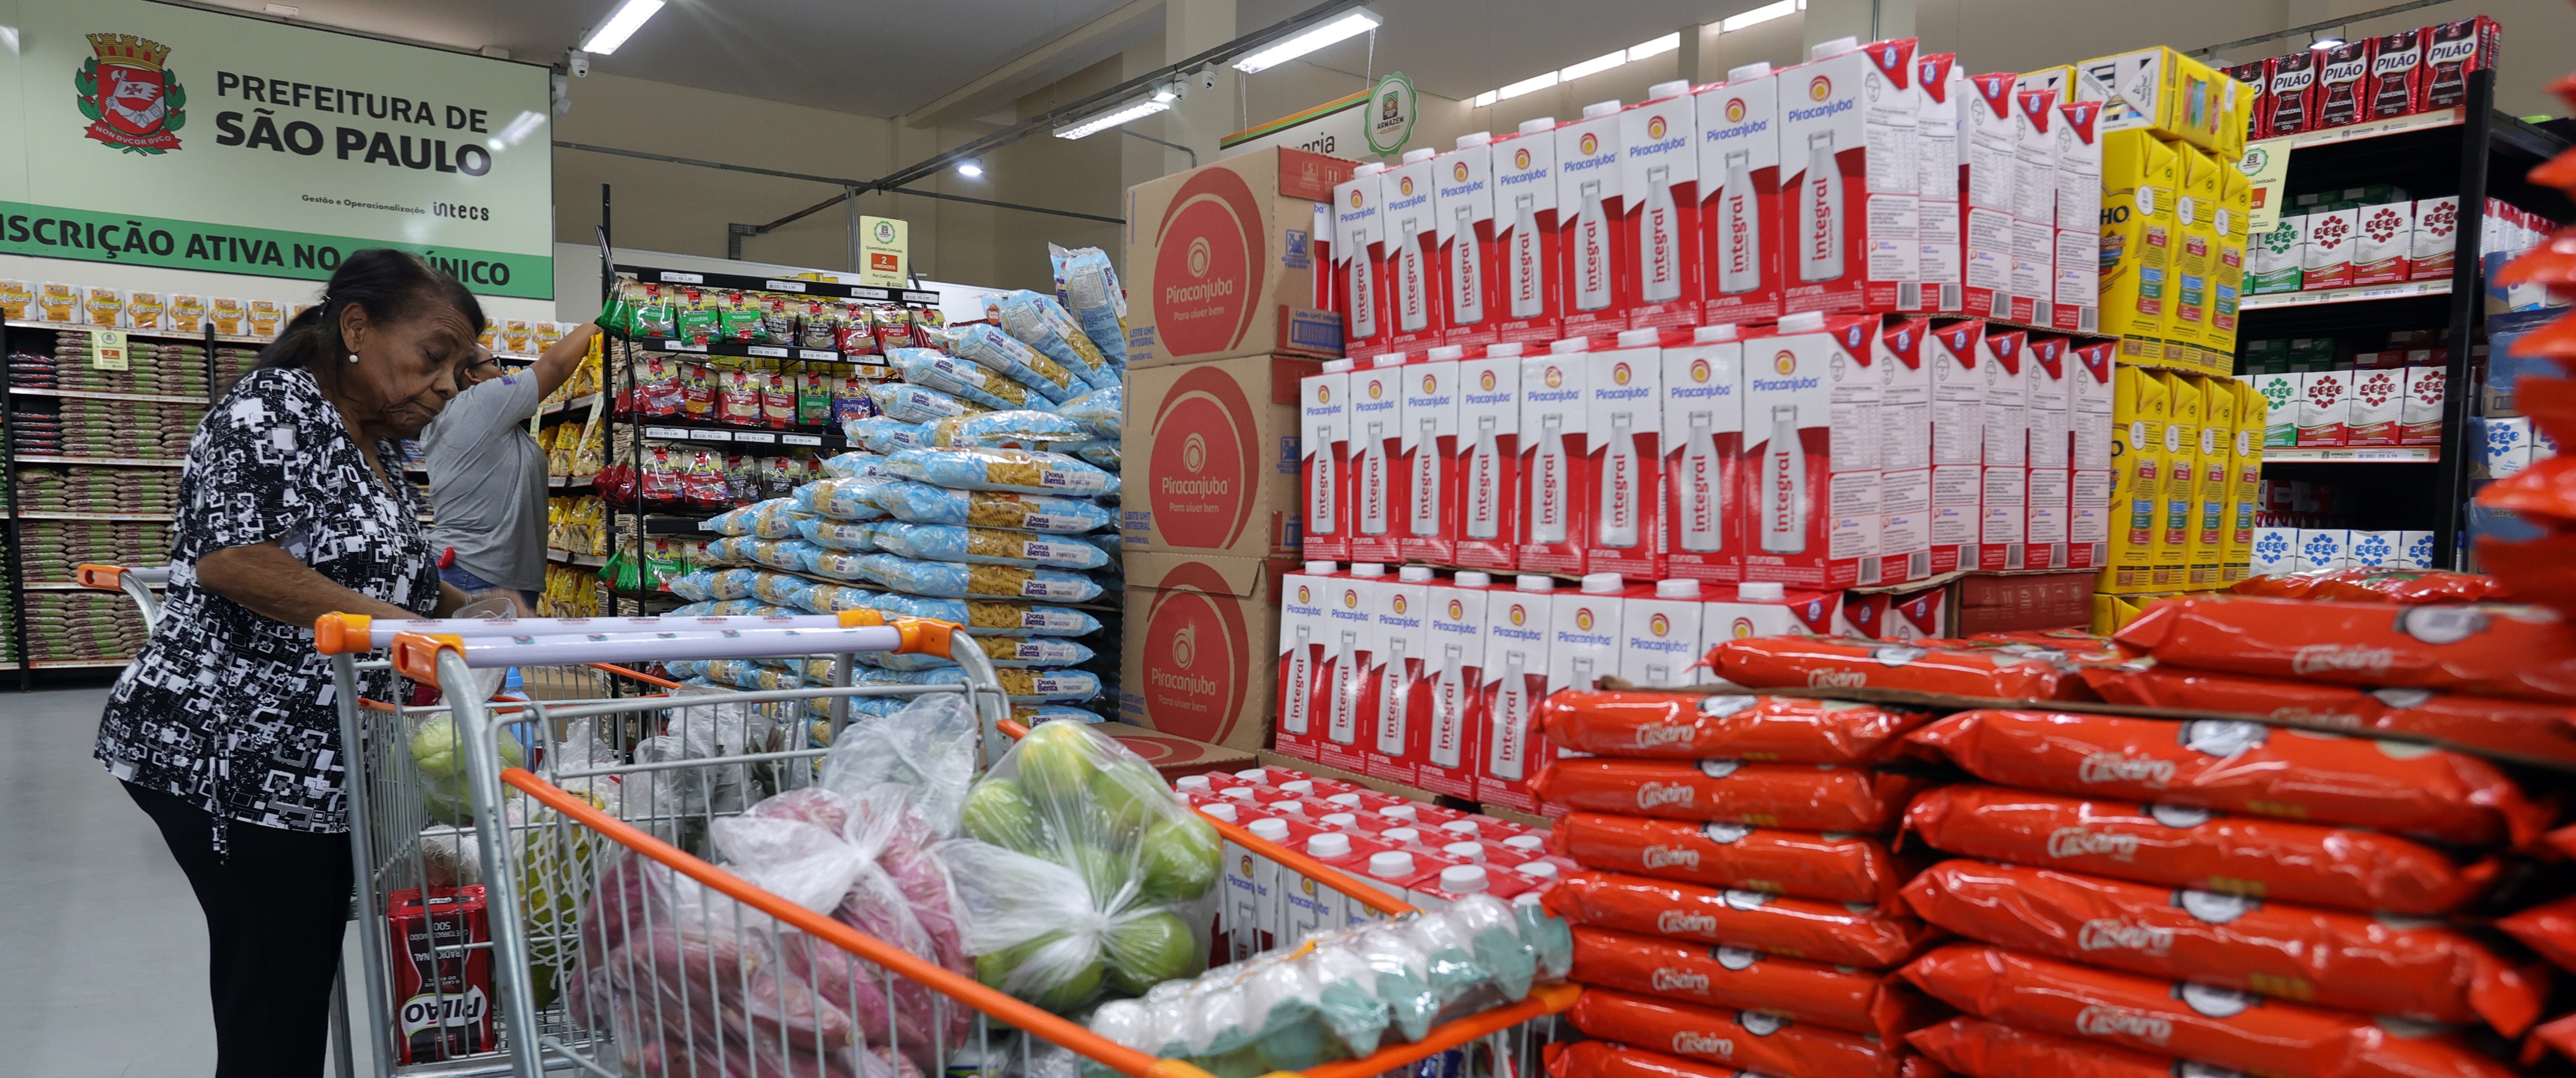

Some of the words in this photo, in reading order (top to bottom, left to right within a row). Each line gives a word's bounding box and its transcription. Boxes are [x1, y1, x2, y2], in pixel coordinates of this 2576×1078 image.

[2430, 42, 2473, 61] PILÃO
[2323, 63, 2362, 81] PILÃO
[2376, 53, 2417, 71] PILÃO
[2274, 73, 2311, 90] PILÃO
[217, 70, 436, 126] PREFEITURA
[446, 105, 487, 134] DE
[1789, 99, 1853, 122] Piracanjuba
[95, 126, 115, 138] NON
[1377, 115, 1404, 131] ARMAZÉM
[1707, 121, 1767, 142] Piracanjuba
[216, 107, 323, 156] SÃO
[336, 127, 491, 177] PAULO
[1630, 137, 1685, 157] Piracanjuba
[1564, 155, 1616, 173] Piracanjuba
[1501, 169, 1547, 186] Piracanjuba
[1441, 181, 1483, 198] Piracanjuba
[302, 195, 334, 204] Gestão
[344, 200, 425, 215] Operacionalização
[433, 202, 489, 221] intecs
[1389, 195, 1426, 211] Piracanjuba
[1340, 206, 1376, 223] Piracanjuba
[1811, 177, 1830, 262] integral
[2365, 217, 2402, 232] gege
[0, 214, 174, 259] SCRIÇÃO
[185, 233, 284, 267] ATIVA
[294, 244, 340, 271] NO
[1730, 195, 1746, 274] integral
[2265, 230, 2298, 245] gege
[2314, 225, 2349, 240] gege
[1585, 220, 1599, 292] integral
[1652, 208, 1667, 284] integral
[1461, 242, 1472, 308] integral
[1519, 232, 1533, 300] integral
[1166, 277, 1232, 304] Piracanjuba
[1356, 262, 1367, 323] integral
[1406, 252, 1418, 316] integral
[1174, 312, 1189, 321] Para
[1190, 309, 1207, 318] viver
[1209, 306, 1224, 315] bem
[1596, 386, 1648, 400] Piracanjuba
[1671, 384, 1730, 399] Piracanjuba
[1753, 377, 1818, 392] Piracanjuba
[2261, 386, 2294, 399] gege
[2308, 385, 2343, 399] gege
[2360, 383, 2396, 396] gege
[1356, 401, 1394, 412] Piracanjuba
[1409, 396, 1450, 408] Piracanjuba
[1466, 392, 1510, 405] Piracanjuba
[1529, 390, 1578, 403] Piracanjuba
[1307, 405, 1341, 416] Piracanjuba
[1162, 476, 1227, 499] Piracanjuba
[1317, 459, 1329, 519] integral
[1368, 457, 1380, 519] integral
[1418, 455, 1432, 519] integral
[1475, 454, 1490, 521] integral
[1540, 454, 1555, 525] integral
[1613, 454, 1628, 527] integral
[1692, 455, 1708, 533] integral
[1773, 451, 1793, 533] integral
[1170, 503, 1184, 512] Para
[2256, 541, 2289, 553] gege
[2304, 543, 2339, 555] gege
[2355, 544, 2392, 557] gege
[1287, 604, 1321, 617] Piracanjuba
[1332, 609, 1369, 622] Piracanjuba
[1379, 614, 1420, 629] Piracanjuba
[1434, 620, 1477, 634] Piracanjuba
[1493, 626, 1541, 641] Piracanjuba
[1630, 637, 1688, 653] Piracanjuba
[1152, 668, 1216, 696] Piracanjuba
[1291, 659, 1304, 718] integral
[1336, 666, 1349, 728] integral
[1384, 674, 1399, 738] integral
[1438, 682, 1454, 750] integral
[1499, 691, 1517, 762] integral
[1636, 721, 1695, 748] Caseiro
[1638, 781, 1694, 808] Caseiro
[1643, 844, 1700, 870] Caseiro
[1658, 909, 1716, 935] Caseiro
[1652, 968, 1710, 992] Caseiro
[405, 996, 480, 1025] PILÃO
[1672, 1032, 1733, 1057] Caseiro
